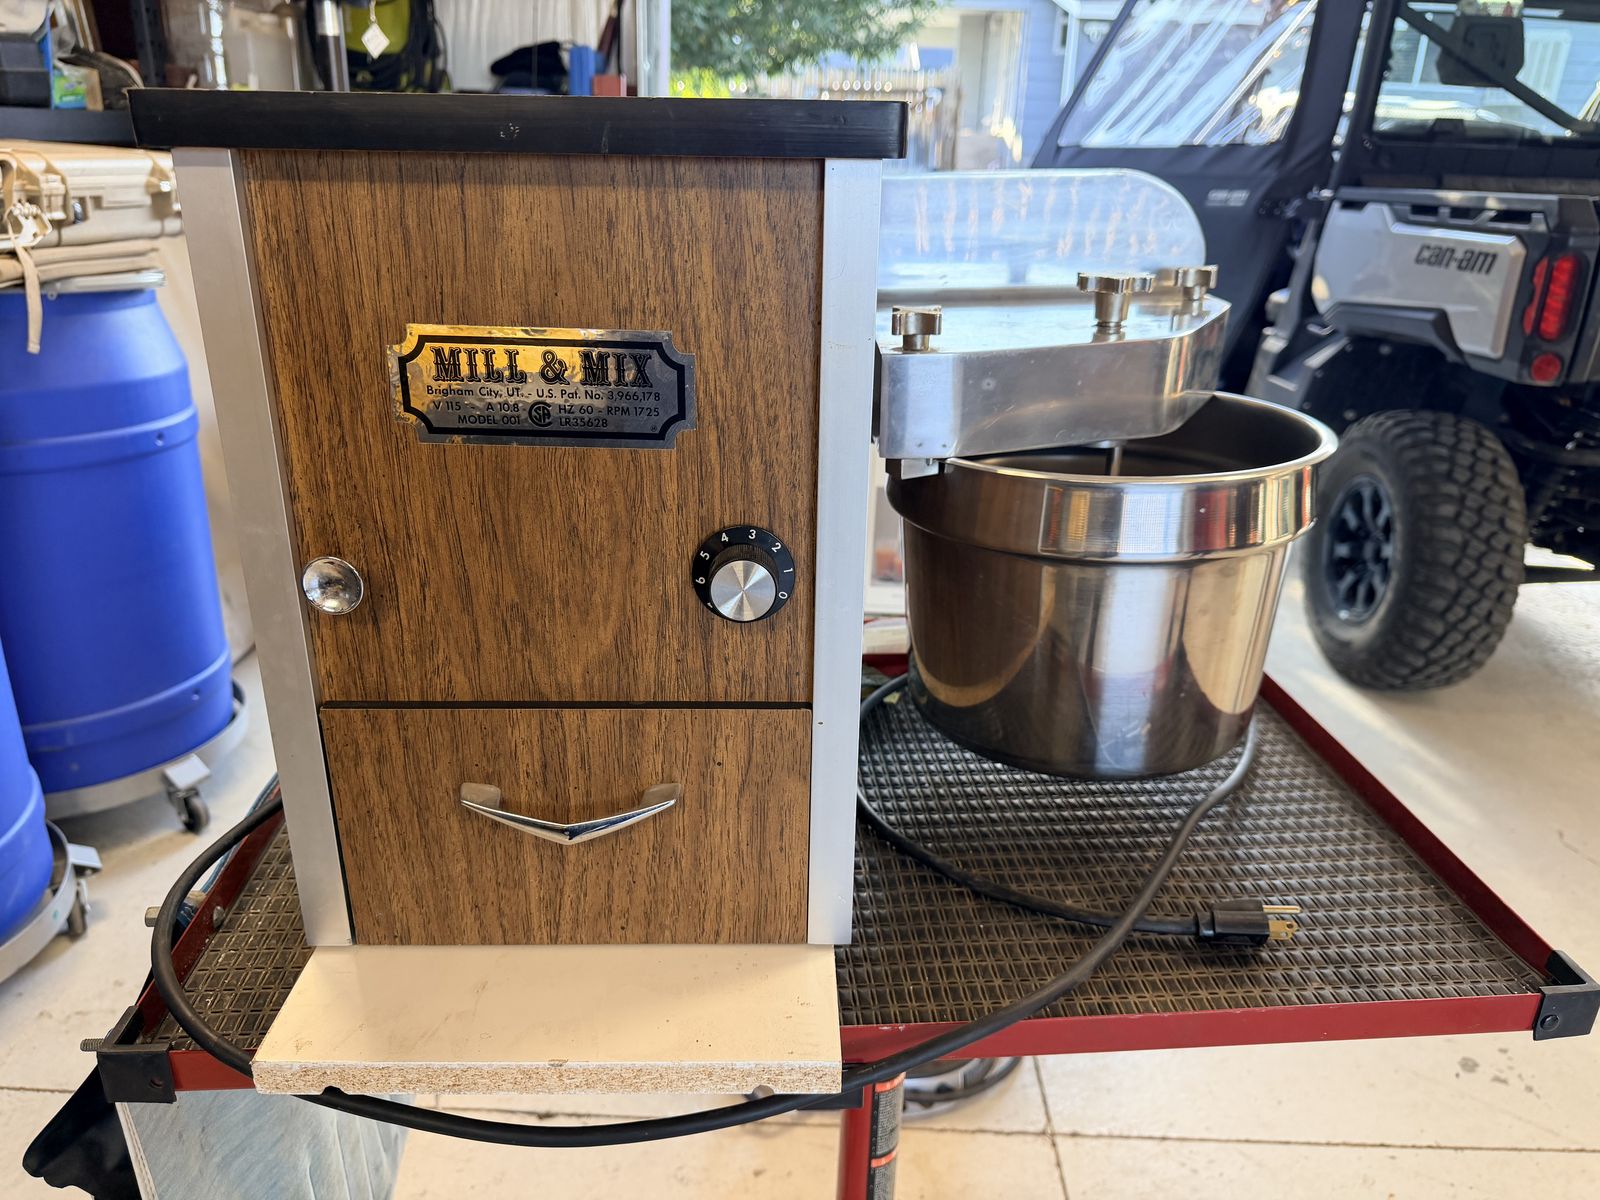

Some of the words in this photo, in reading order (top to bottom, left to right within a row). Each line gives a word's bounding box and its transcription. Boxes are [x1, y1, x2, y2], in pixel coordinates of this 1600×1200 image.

[1414, 243, 1498, 275] can-am
[430, 346, 527, 384] MILL
[539, 349, 571, 386] &
[578, 350, 653, 388] MIX
[426, 385, 474, 397] Brigham
[478, 387, 503, 398] City,
[506, 388, 524, 398] UT.
[536, 388, 557, 399] U.S.
[560, 390, 581, 400] Pat.
[584, 390, 604, 401] No.
[607, 391, 661, 402] 3,966,178
[432, 401, 441, 410] V
[446, 401, 461, 411] 115
[486, 402, 495, 412] A
[499, 402, 520, 413] 10.8
[558, 404, 575, 415] HZ
[579, 405, 594, 415] 60
[606, 406, 631, 417] RPM
[634, 406, 660, 417] 1725
[457, 414, 498, 425] MODEL
[501, 415, 521, 426] 001
[559, 417, 609, 428] LR35628
[721, 532, 729, 542] 4
[748, 529, 757, 540] 3
[771, 542, 782, 553] 2
[700, 550, 710, 561] 5
[778, 591, 788, 600] 0
